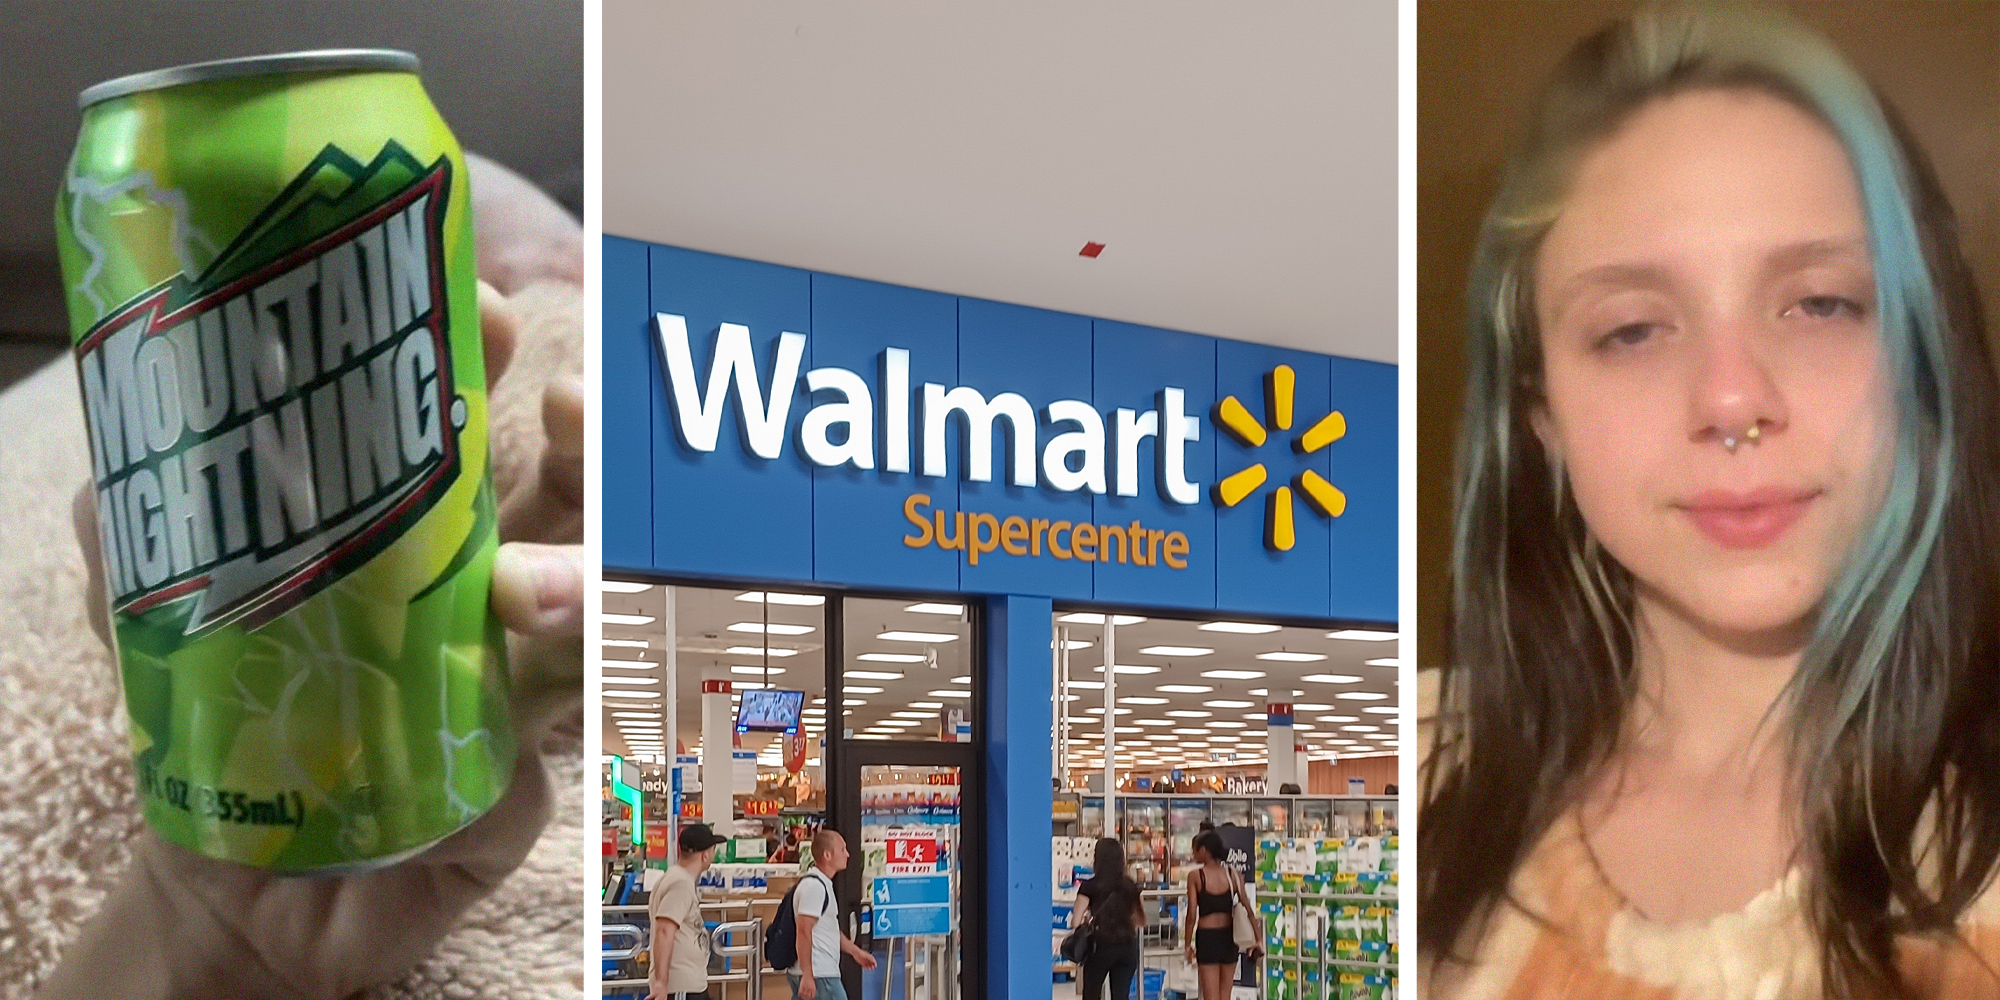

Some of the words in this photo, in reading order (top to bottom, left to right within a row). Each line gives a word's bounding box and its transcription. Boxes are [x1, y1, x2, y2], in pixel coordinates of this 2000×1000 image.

[81, 192, 433, 483] MOUNTAIN
[654, 311, 1200, 506] Walmart
[903, 493, 1191, 569] Supercentre
[1227, 771, 1269, 796] Bakery
